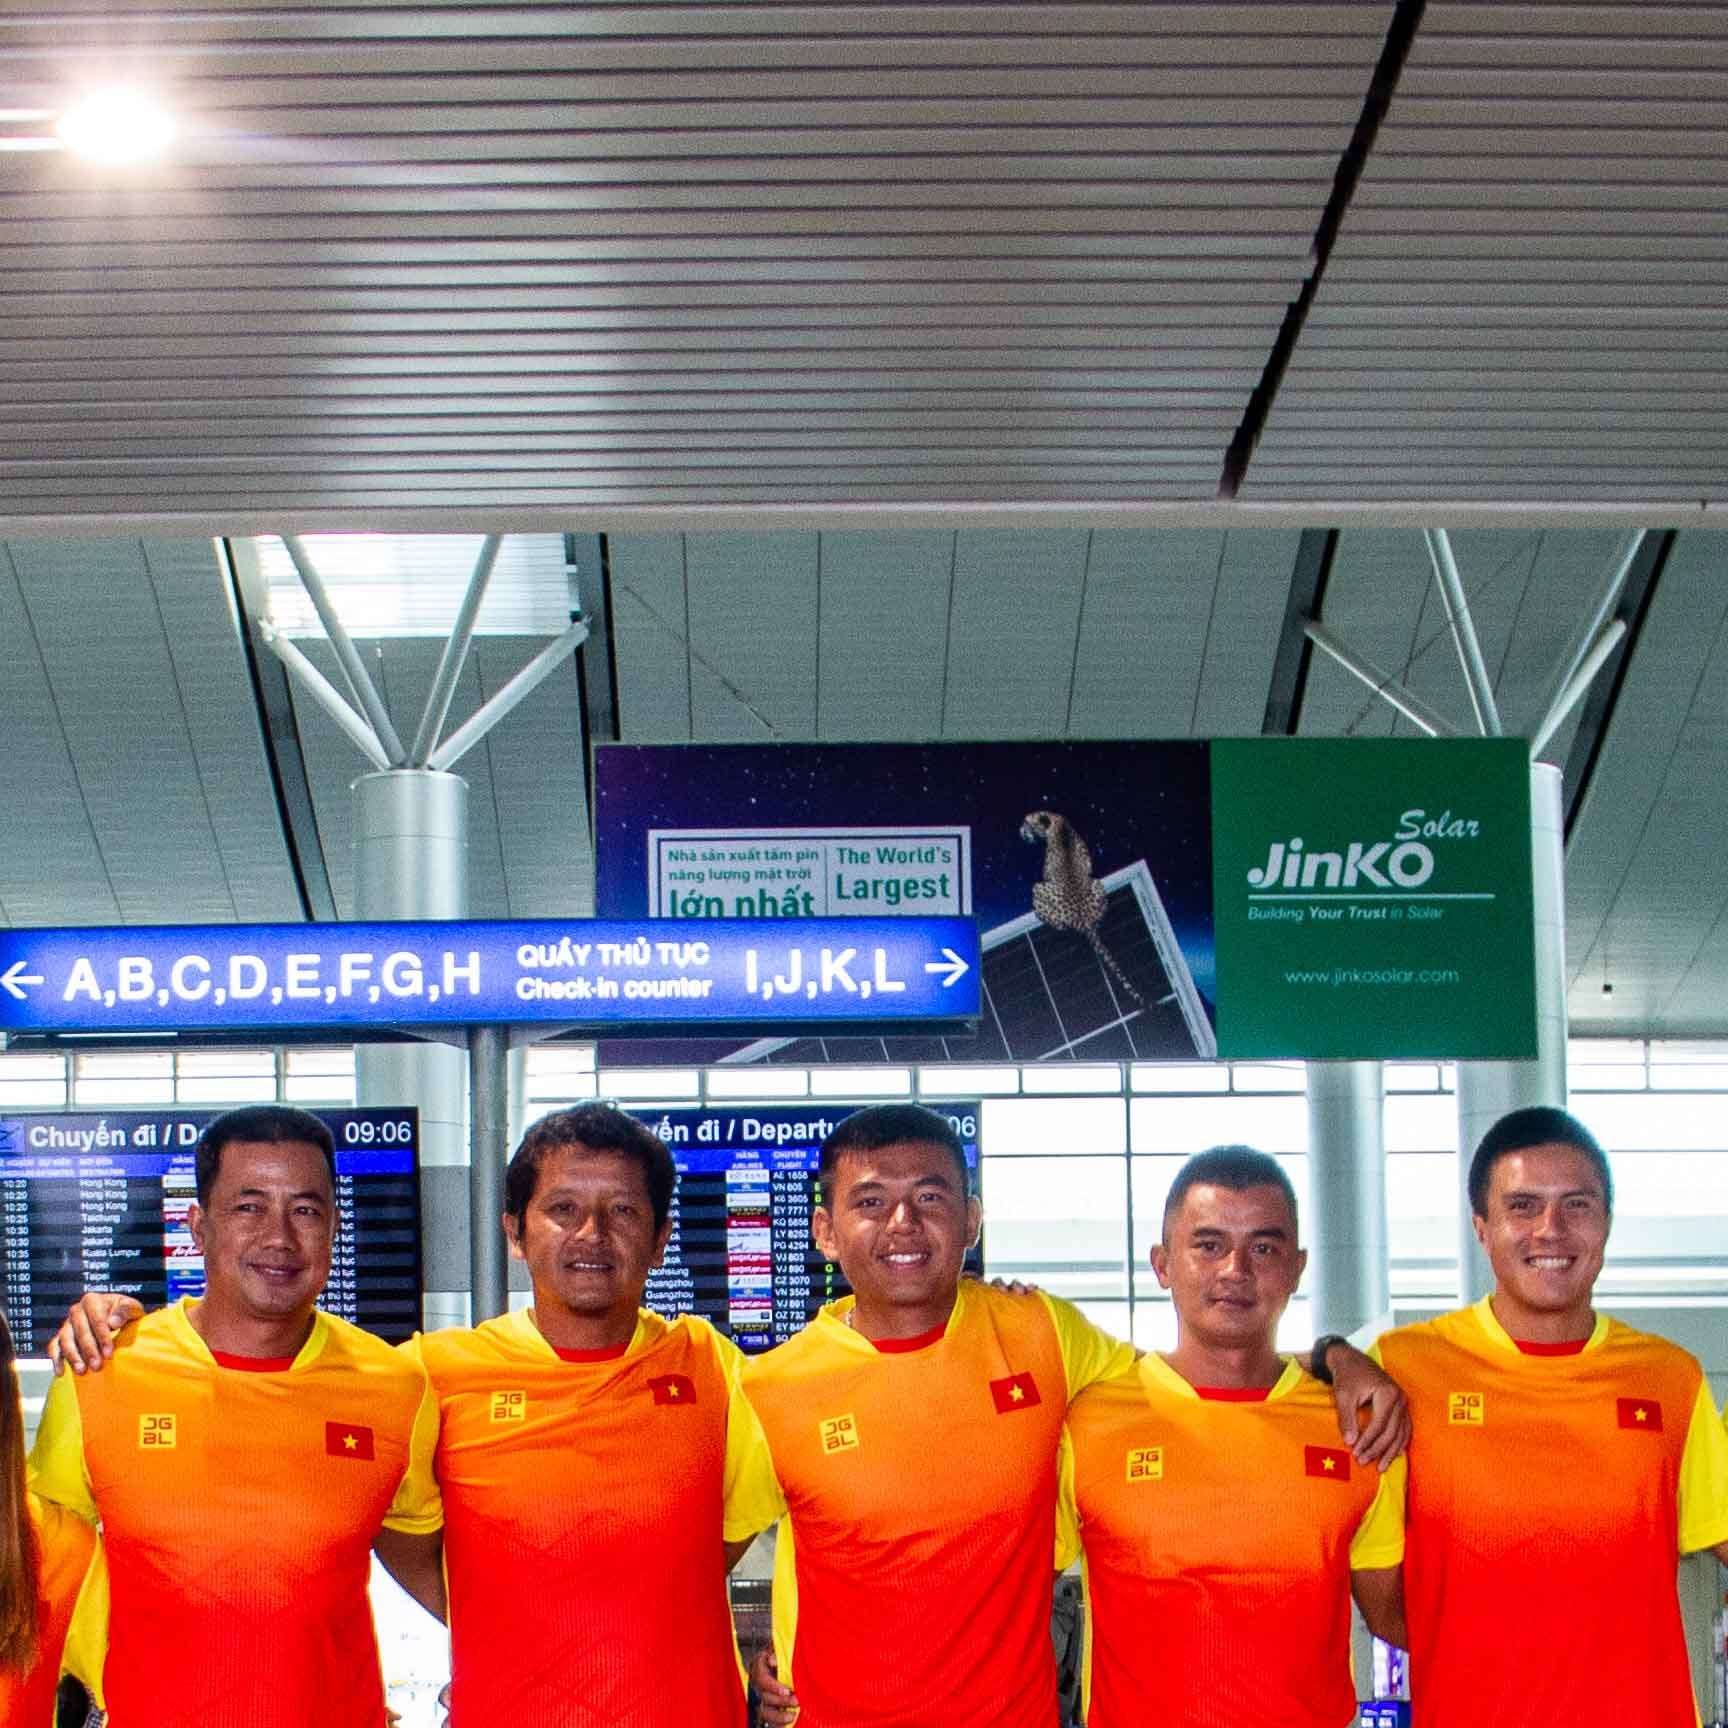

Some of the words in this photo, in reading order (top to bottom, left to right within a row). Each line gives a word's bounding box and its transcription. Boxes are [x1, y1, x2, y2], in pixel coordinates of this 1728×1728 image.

[1395, 809, 1479, 840] Solar
[795, 849, 818, 864] pin
[836, 847, 870, 865] The
[877, 846, 951, 864] World's
[836, 873, 950, 905] Largest
[670, 889, 724, 917] lớn
[736, 884, 814, 917] nhất
[1248, 907, 1304, 924] Building
[1309, 907, 1343, 919] Your
[1348, 906, 1386, 919] Trust
[1390, 907, 1402, 919] in
[1407, 906, 1443, 919] Solar
[597, 936, 651, 966] THỦ
[655, 942, 710, 968] TỤC
[746, 948, 905, 999] I,J,K,L
[1285, 968, 1459, 985] www.jinkosolar.com
[63, 951, 481, 1007] A,B,C,D,E,F,G,H
[516, 976, 618, 1000] Check-in
[624, 977, 713, 999] counter
[29, 1120, 126, 1151] Chuyến
[133, 1124, 156, 1146] đi
[163, 1124, 172, 1145] /
[345, 1121, 411, 1143] 09:06
[696, 1120, 719, 1142] đi
[728, 1119, 736, 1141] /
[3, 1180, 27, 1189] 10:20
[80, 1179, 103, 1189] Hong
[104, 1179, 127, 1189] Kong
[772, 1183, 785, 1191] VN
[4, 1191, 28, 1200] 10:20
[80, 1191, 103, 1200] Hong
[105, 1191, 128, 1200] Kong
[4, 1203, 28, 1212] 10:20
[81, 1203, 104, 1212] Hong
[106, 1202, 128, 1212] Kong
[774, 1206, 785, 1214] EY
[787, 1206, 808, 1214] 7771
[81, 1214, 121, 1224] Taichung
[81, 1226, 113, 1234] Jakarta
[775, 1230, 786, 1238] LY
[82, 1237, 113, 1246] Jakarta
[82, 1249, 107, 1257] Kuala
[109, 1249, 141, 1259] Lumpur
[775, 1253, 787, 1261] VJ
[7, 1262, 30, 1270] 11:00
[83, 1261, 109, 1270] Taipei
[776, 1265, 787, 1273] VJ
[7, 1273, 30, 1282] 11:00
[83, 1272, 110, 1281] Taipei
[775, 1277, 787, 1285] CZ
[7, 1285, 31, 1293] 11:00
[84, 1284, 109, 1292] Kuala
[110, 1284, 143, 1293] Lumpur
[645, 1279, 693, 1289] Guangzhou
[646, 1290, 694, 1300] Guangzhou
[775, 1288, 788, 1296] VN
[646, 1302, 676, 1312] Chiang
[678, 1302, 693, 1311] Mai
[776, 1311, 788, 1319] OZ
[776, 1323, 788, 1331] EY
